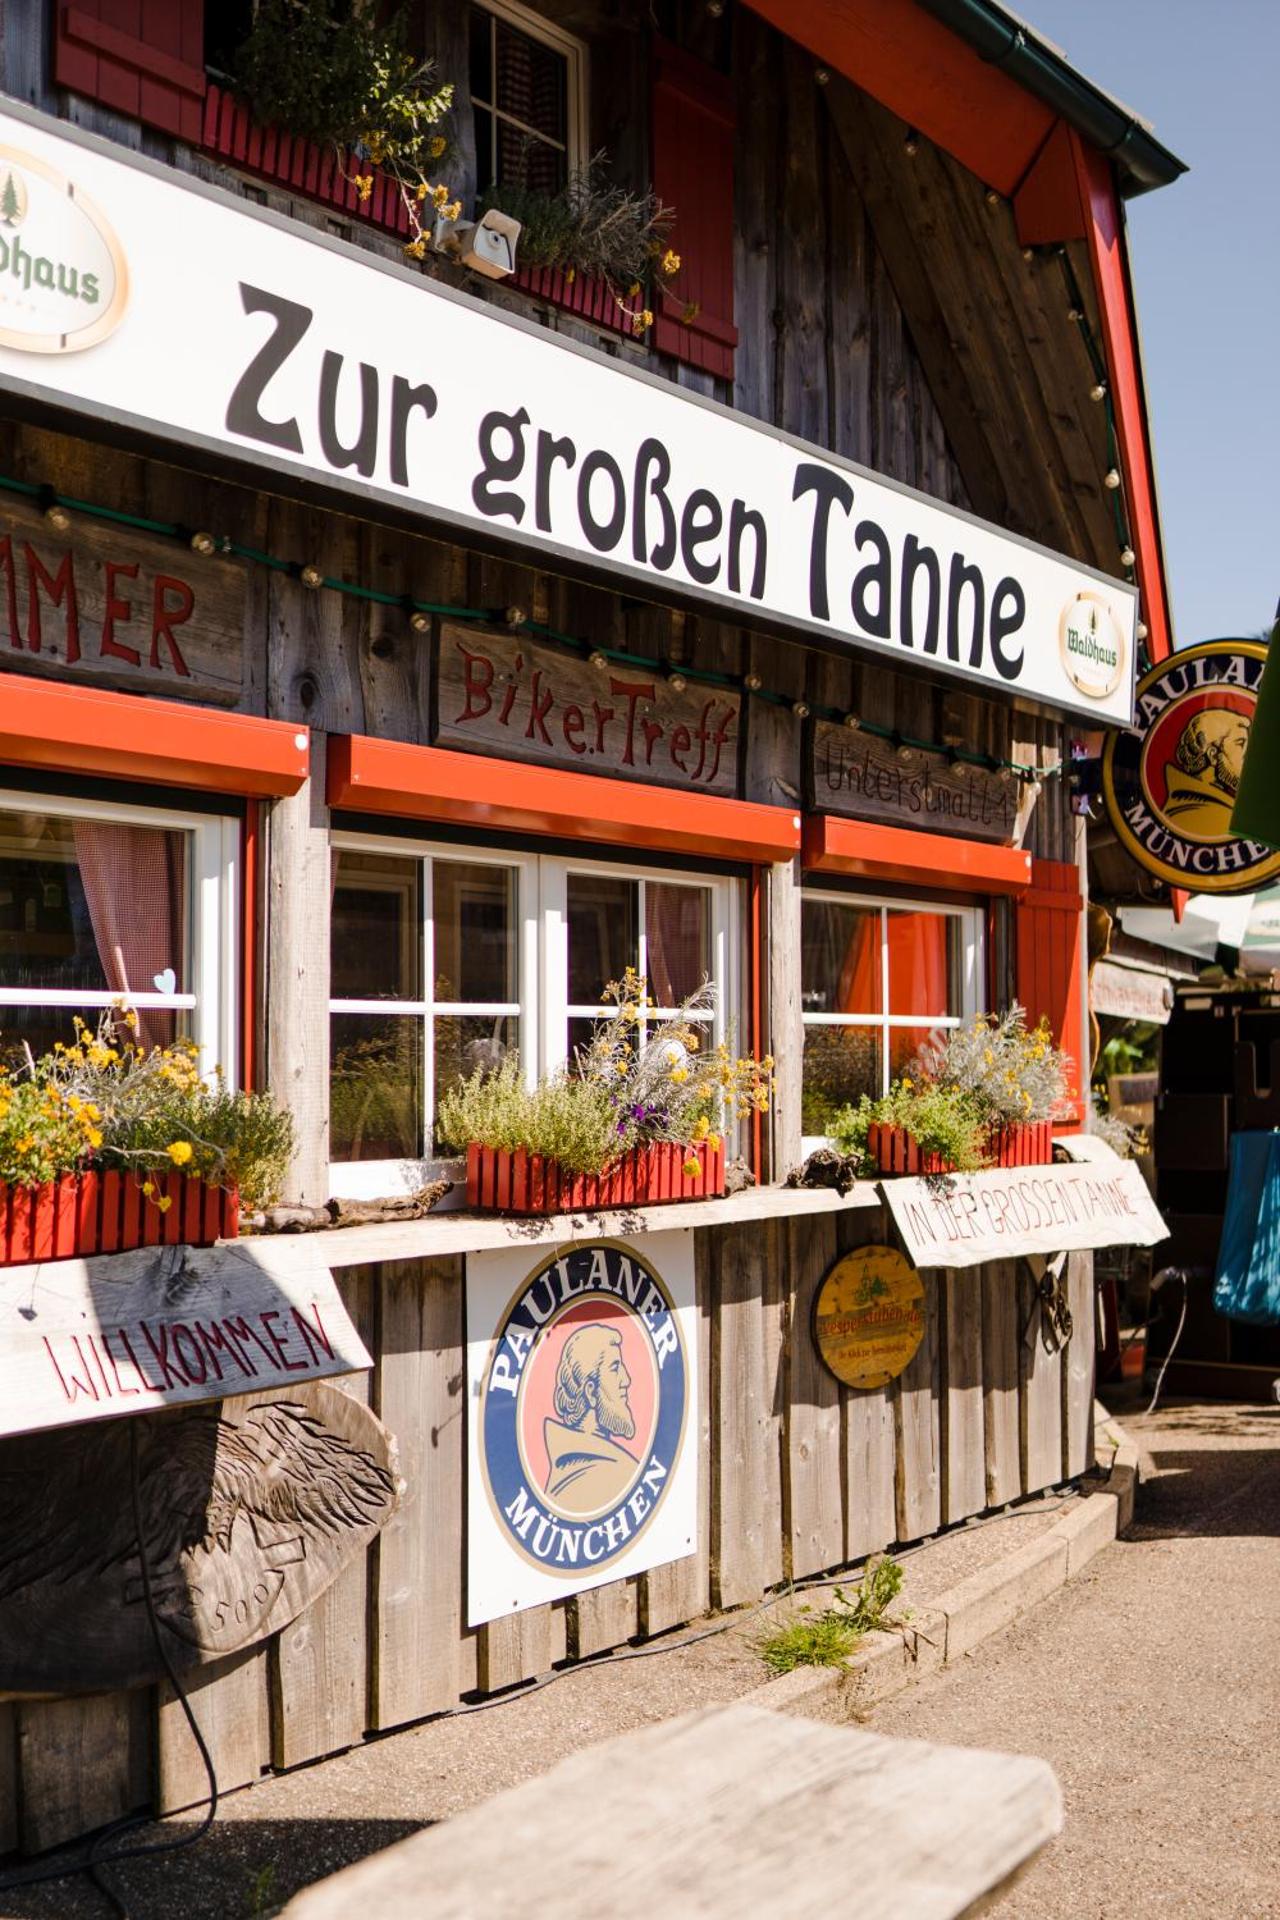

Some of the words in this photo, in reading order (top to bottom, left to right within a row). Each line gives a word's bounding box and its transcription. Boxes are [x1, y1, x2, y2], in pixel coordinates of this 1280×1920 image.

[225, 281, 438, 488] Zur
[471, 406, 768, 601] großen
[792, 462, 1027, 681] Tanne
[1067, 627, 1117, 667] Waldhaus
[903, 1199, 937, 1247] IN
[930, 1192, 984, 1242] DER
[981, 1179, 1079, 1236] GROSSEN
[1067, 1177, 1138, 1222] TANNE
[42, 1302, 336, 1403] WILLKOMMEN
[489, 1250, 679, 1397] PAULANER
[504, 1455, 667, 1563] MÜNCHEN
